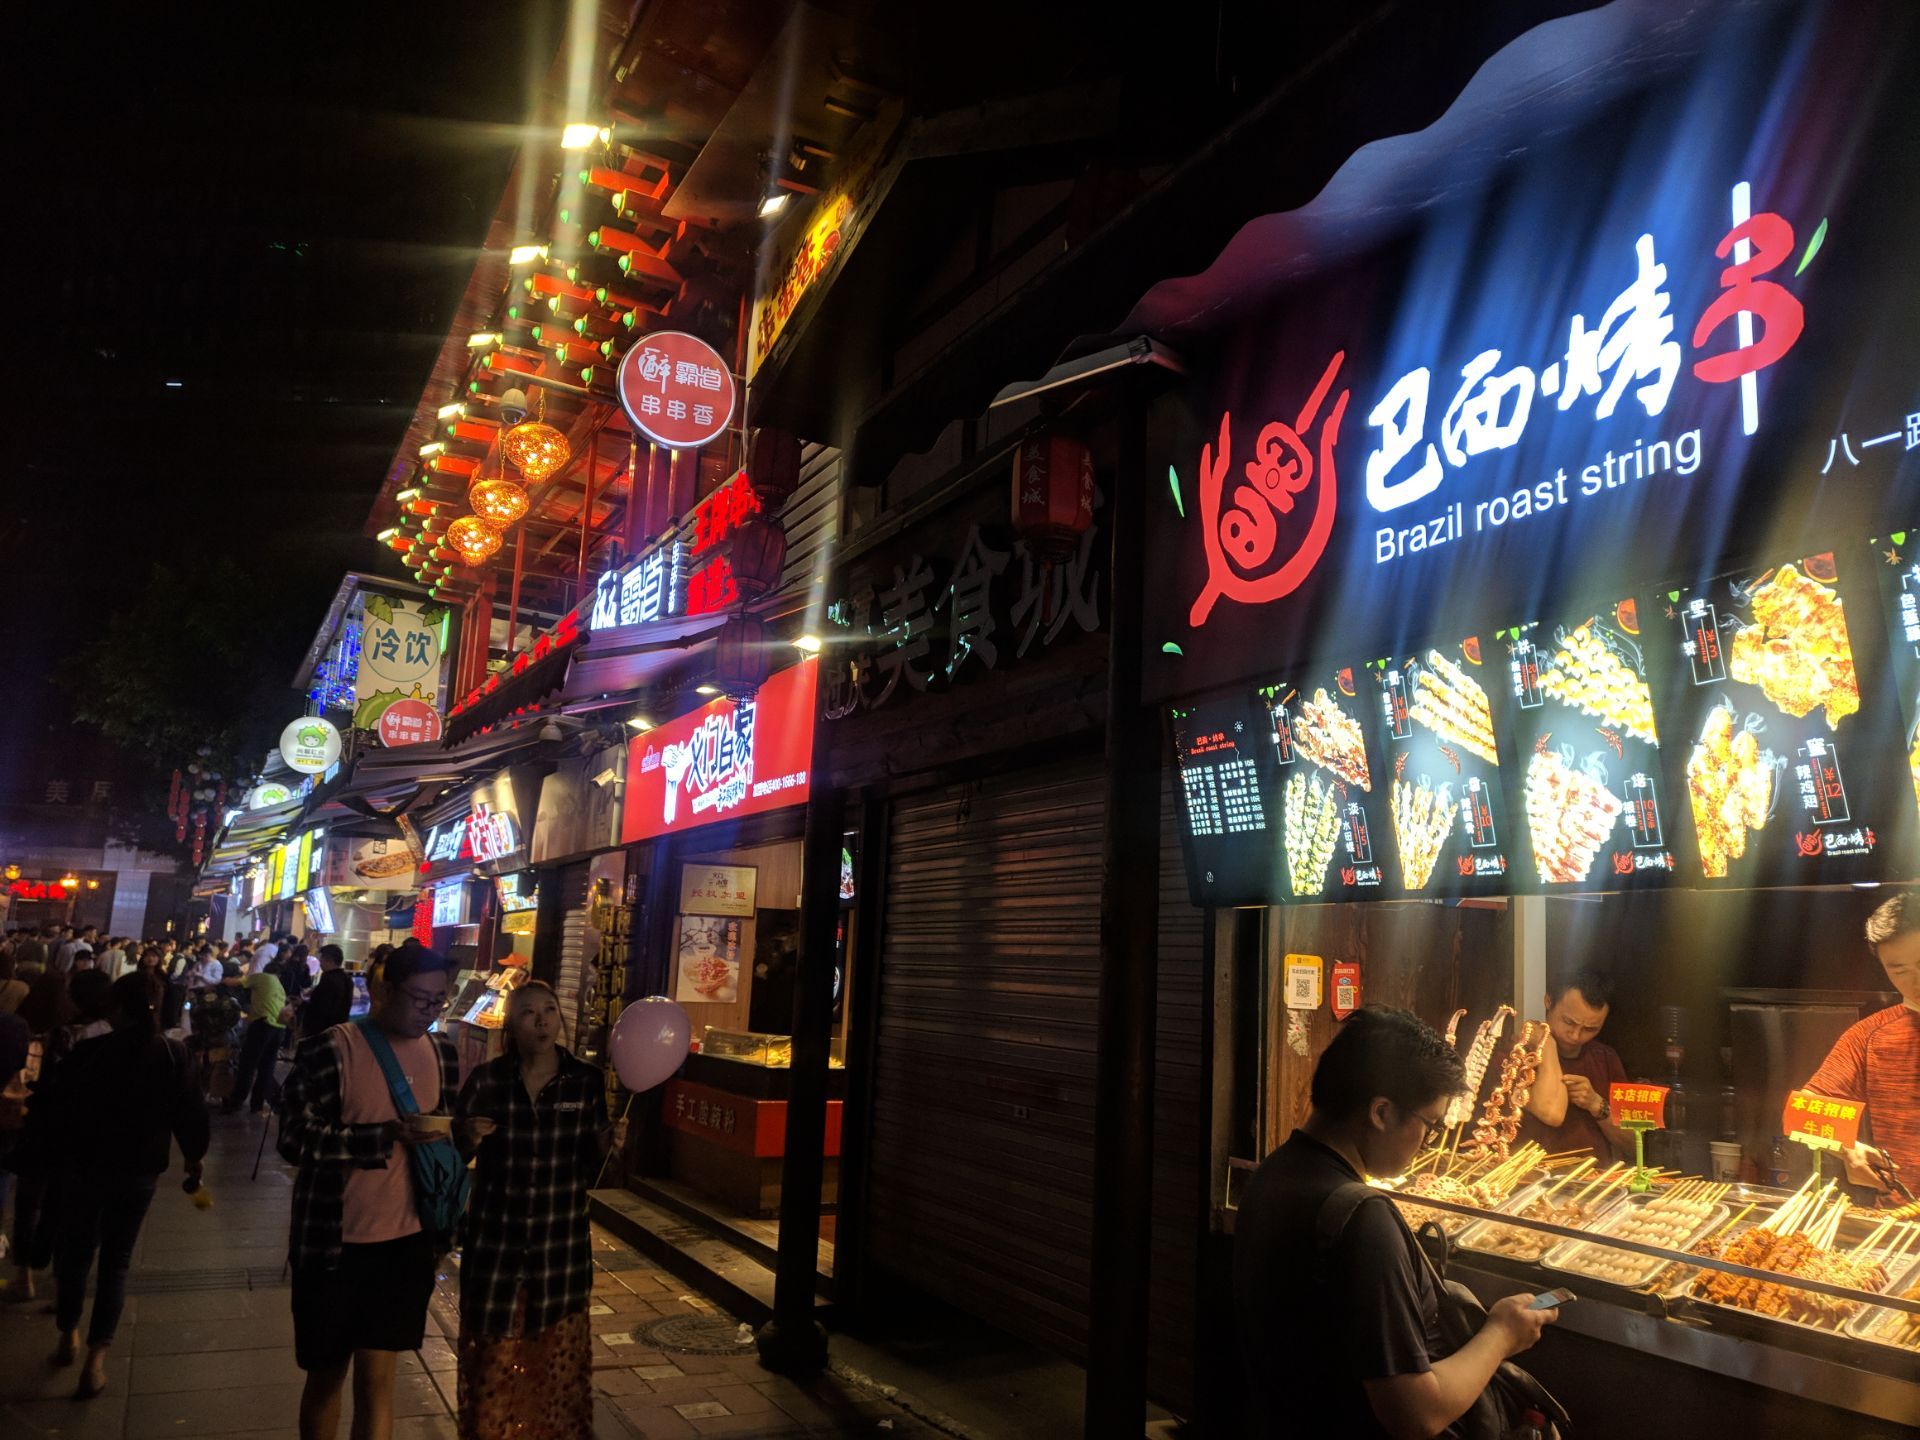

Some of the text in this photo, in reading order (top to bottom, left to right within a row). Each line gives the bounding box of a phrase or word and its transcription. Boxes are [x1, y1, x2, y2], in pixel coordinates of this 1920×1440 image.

[641, 394, 714, 425] 串串香
[1376, 428, 1701, 564] Brazil roast string
[372, 627, 432, 667] 冷饮
[1823, 768, 1842, 798] ¥12
[1613, 1088, 1662, 1104] 本店招牌
[1791, 1096, 1857, 1121] 本店招牌
[1803, 1120, 1835, 1140] 牛肉
